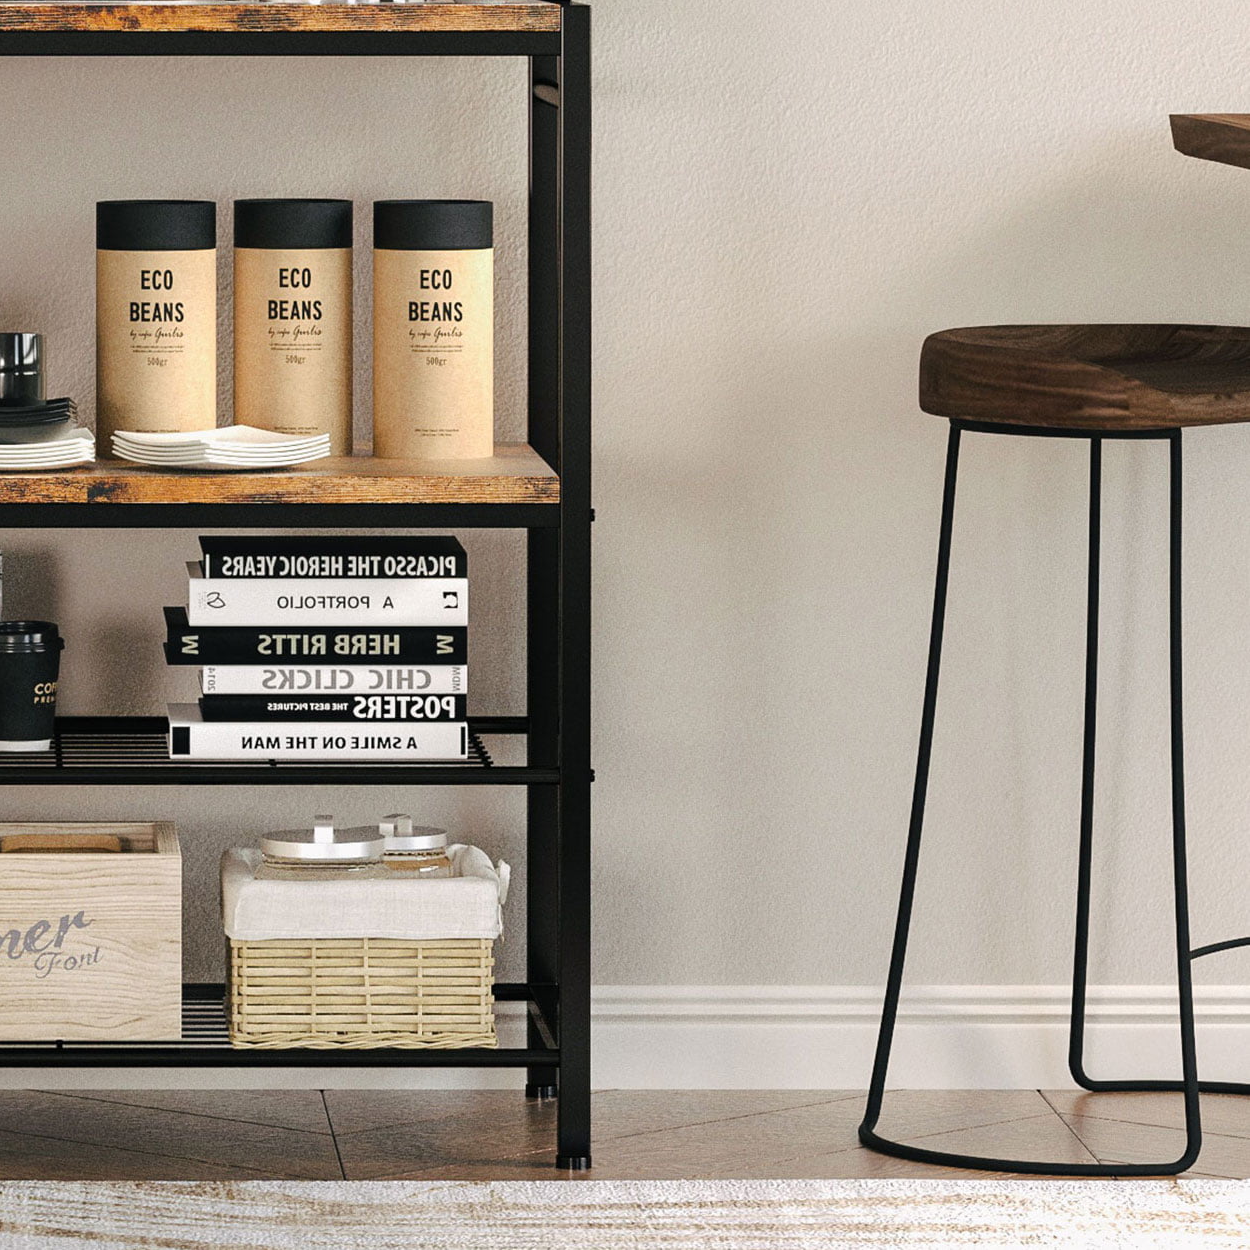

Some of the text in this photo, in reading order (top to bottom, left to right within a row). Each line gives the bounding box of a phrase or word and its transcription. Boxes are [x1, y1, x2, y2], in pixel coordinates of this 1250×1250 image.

[141, 270, 173, 290] ECO
[278, 268, 312, 288] ECO
[420, 269, 452, 290] ECO
[130, 302, 184, 322] BEANS
[268, 300, 322, 320] BEANS
[408, 302, 463, 322] BEANS
[147, 357, 168, 366] 500gr
[285, 354, 306, 364] 500gr
[426, 356, 448, 366] 500gr
[34, 946, 104, 979] Font
